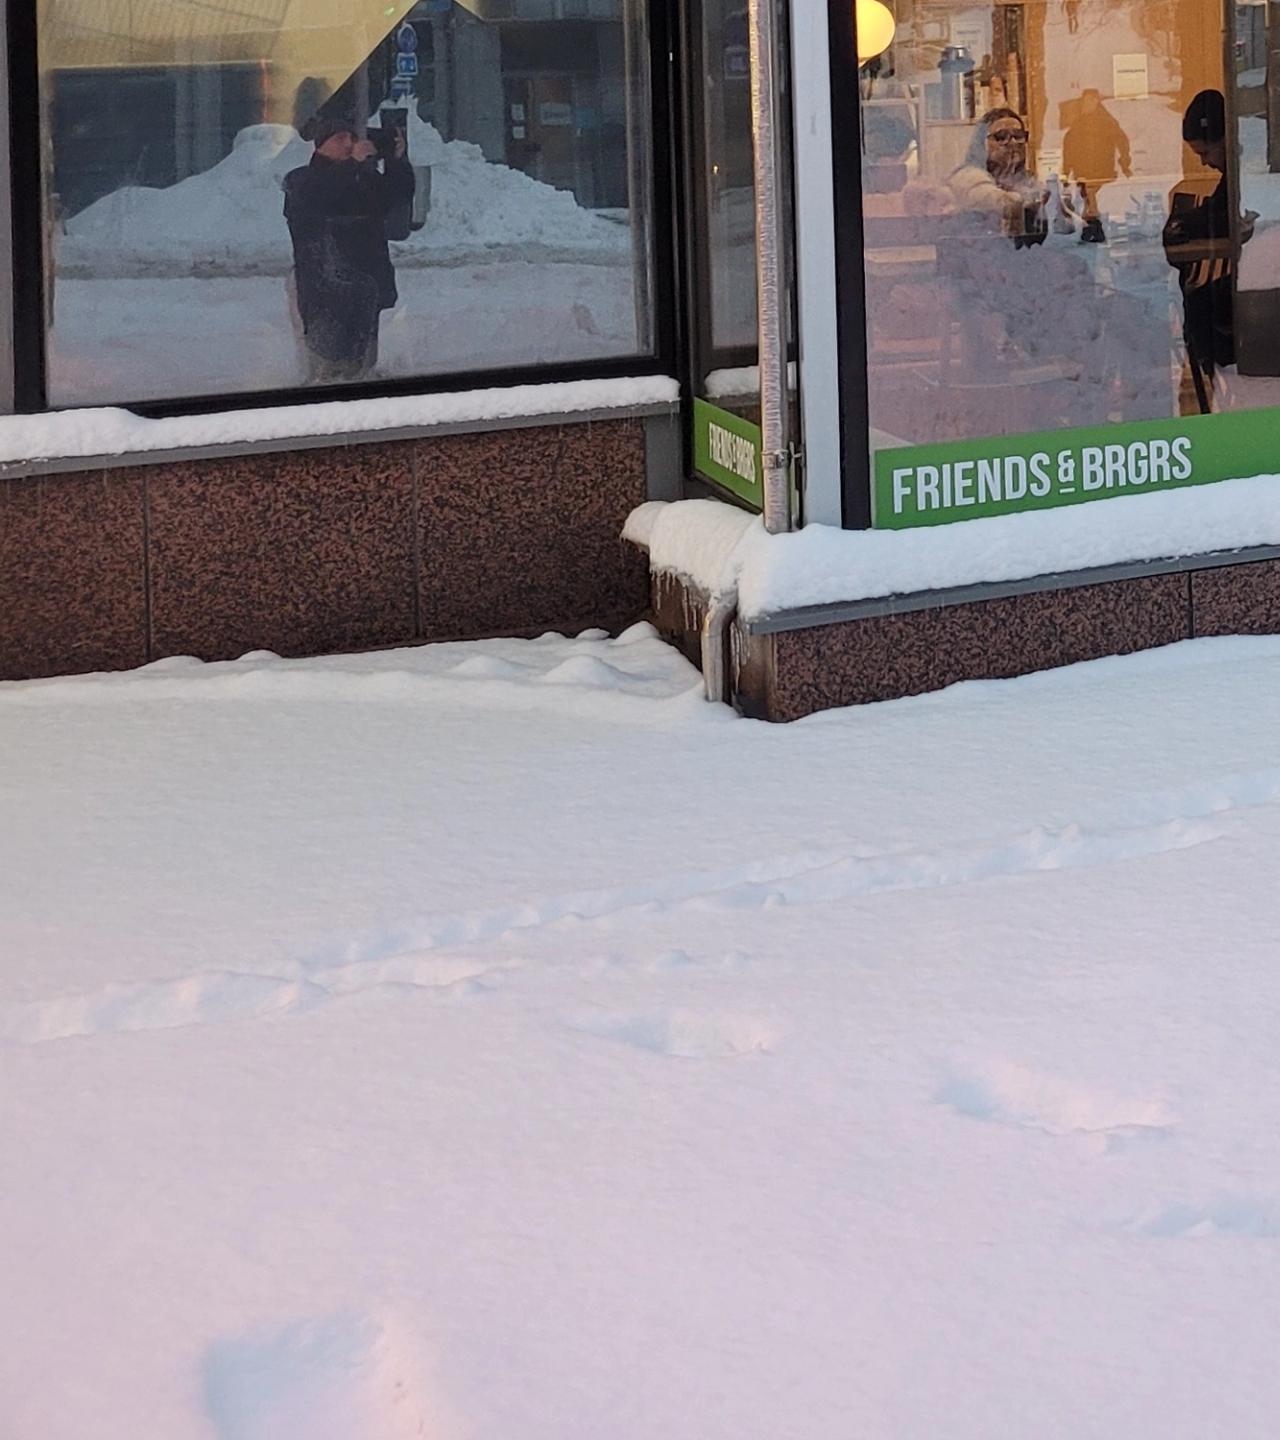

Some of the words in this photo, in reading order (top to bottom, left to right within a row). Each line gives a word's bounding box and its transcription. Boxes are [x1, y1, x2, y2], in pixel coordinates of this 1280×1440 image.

[892, 451, 1051, 514] FRIENDS
[1058, 449, 1076, 494] &
[1082, 436, 1193, 491] BRGRS
